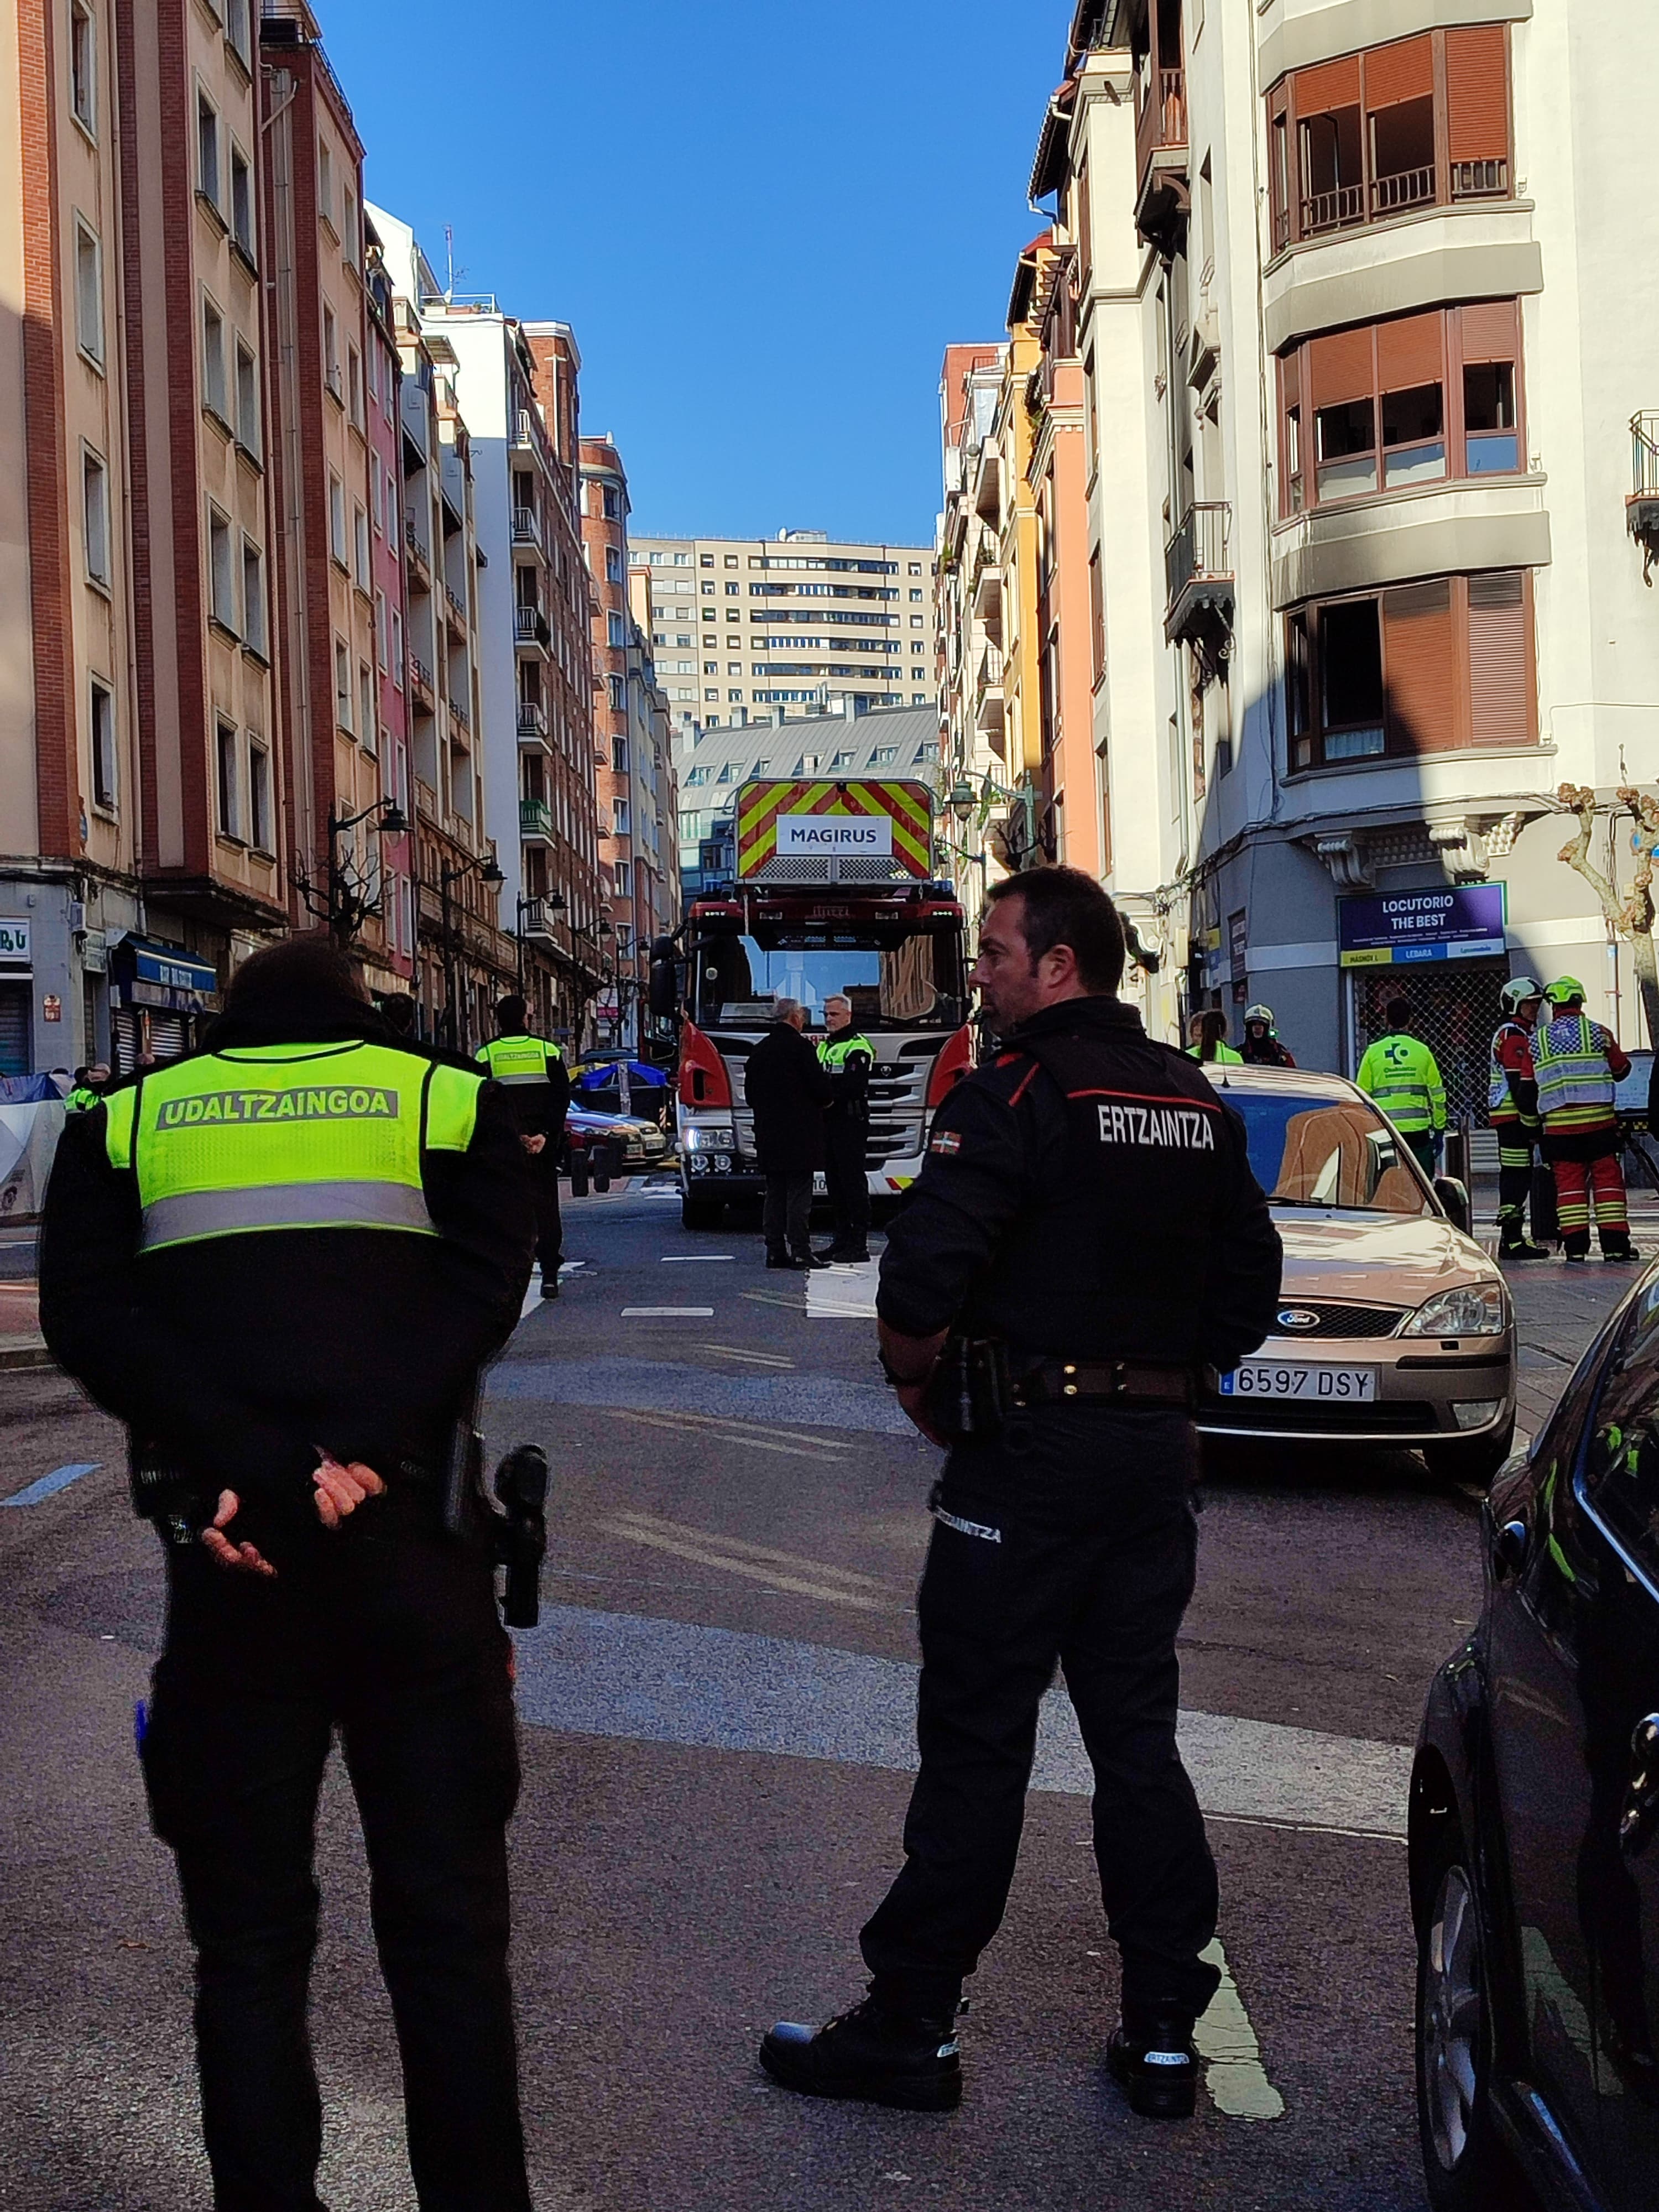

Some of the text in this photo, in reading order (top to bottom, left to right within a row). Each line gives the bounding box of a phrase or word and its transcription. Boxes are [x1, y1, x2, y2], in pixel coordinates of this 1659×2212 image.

[791, 828, 877, 843] MAGIRUS
[1383, 895, 1454, 913] LOCUTORIO
[1391, 914, 1446, 930] THE BEST
[165, 1089, 389, 1125] UDALTZAINGOA
[1098, 1104, 1214, 1151] ERTZAINTZA
[1287, 1314, 1310, 1323] Ford
[1239, 1368, 1369, 1397] 6597 DSY
